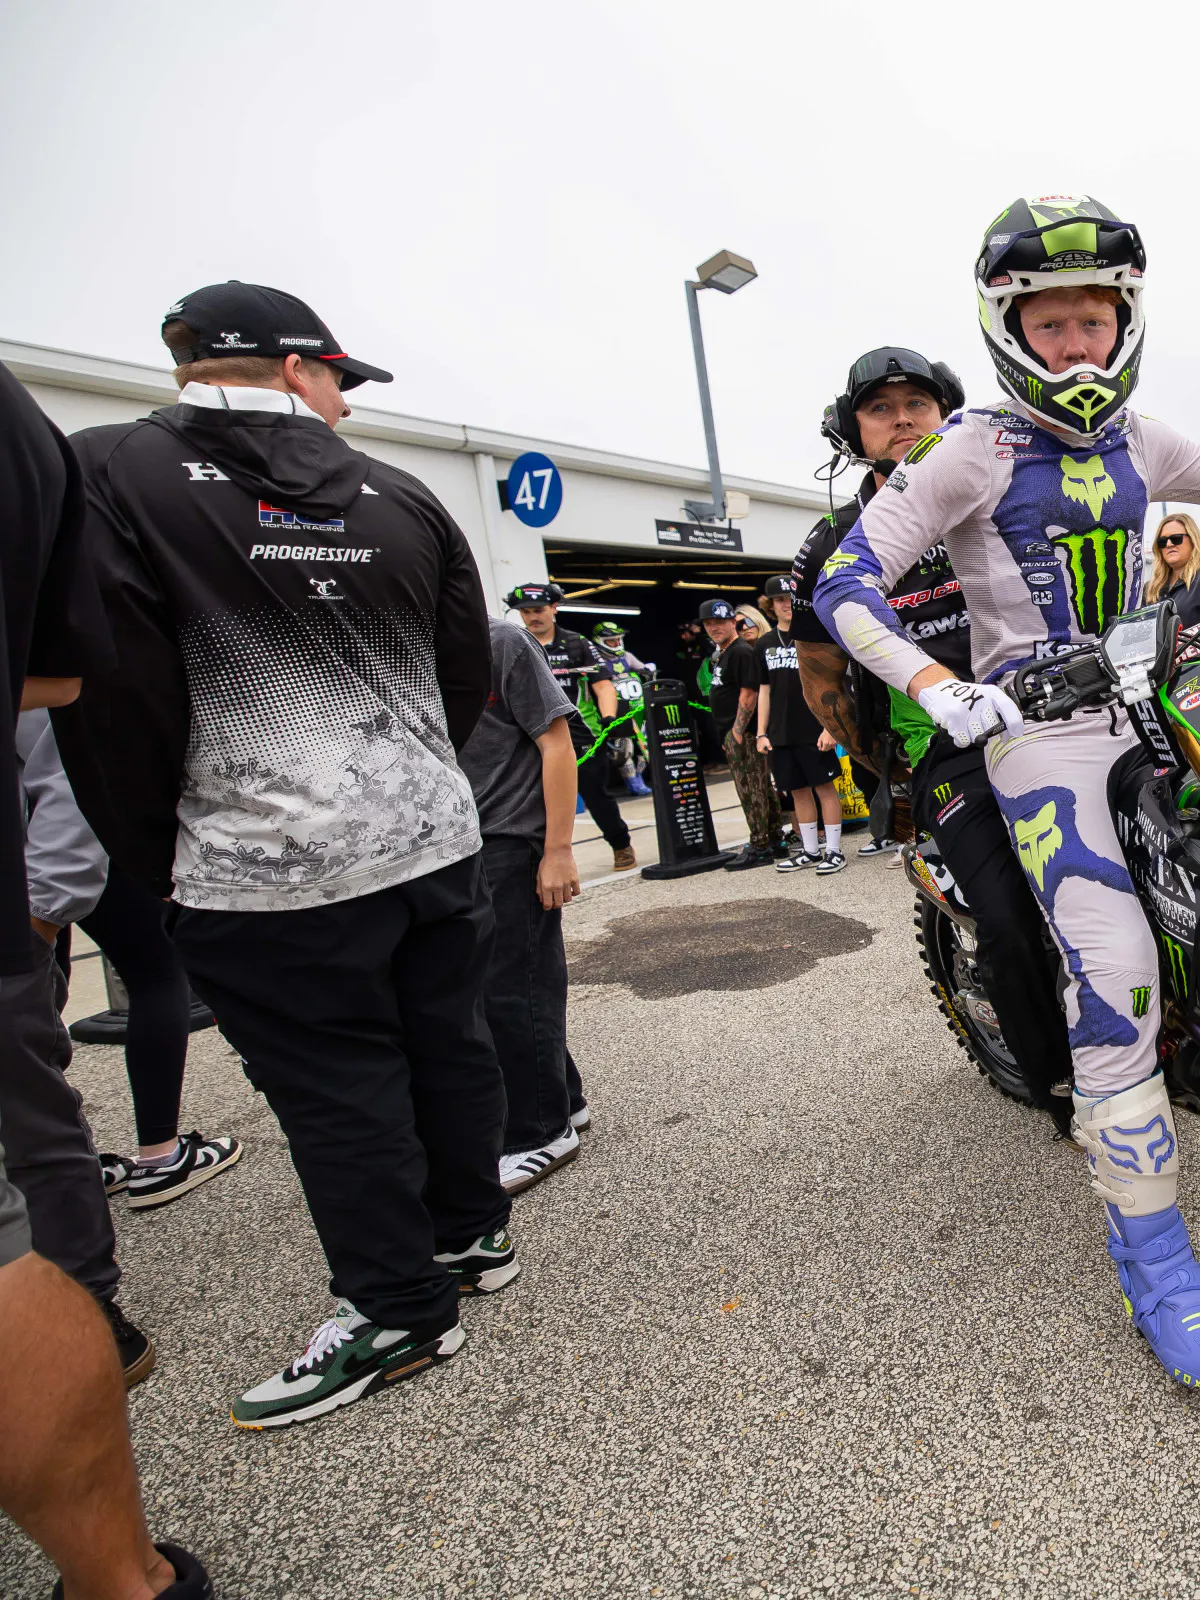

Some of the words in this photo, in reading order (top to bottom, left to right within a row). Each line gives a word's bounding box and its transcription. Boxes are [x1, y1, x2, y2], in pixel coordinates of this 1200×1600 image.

[1040, 262, 1063, 270] PRO
[1065, 259, 1109, 268] CIRCUIT
[280, 337, 323, 348] PROGRESSIVE
[514, 468, 553, 511] 47
[260, 522, 301, 530] Honda
[303, 524, 345, 533] RACING
[250, 544, 374, 563] PROGRESSIVE
[1021, 560, 1061, 568] DUNLOP
[940, 683, 984, 711] FOX
[939, 801, 966, 827] Kawasaki
[1163, 917, 1188, 936] 2026
